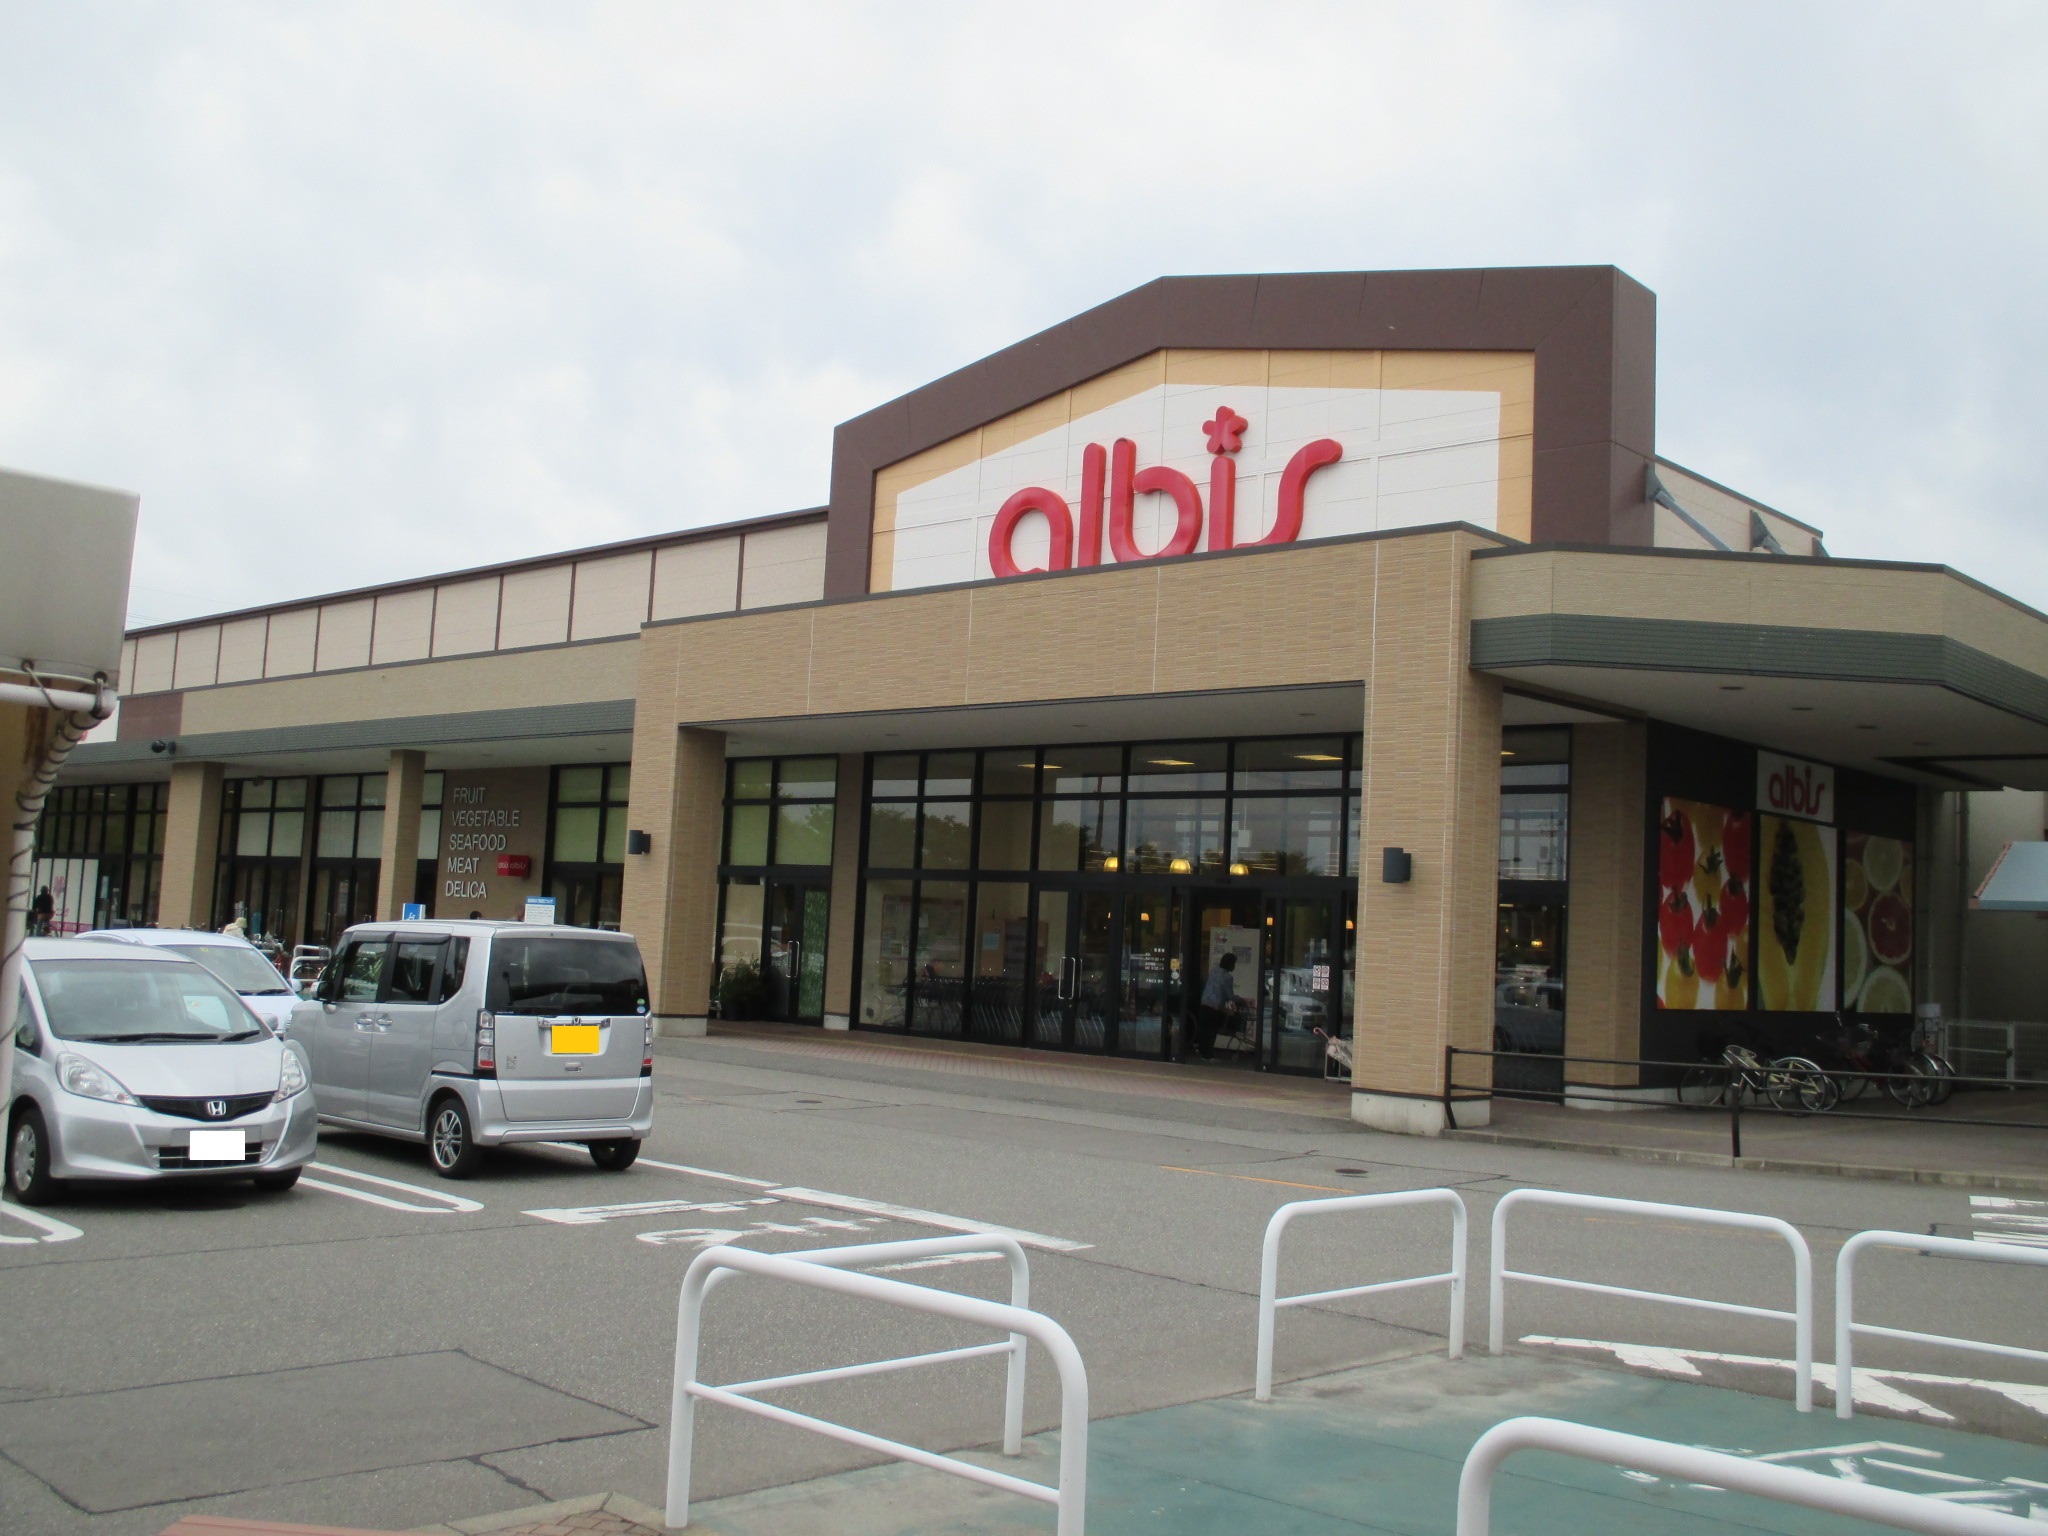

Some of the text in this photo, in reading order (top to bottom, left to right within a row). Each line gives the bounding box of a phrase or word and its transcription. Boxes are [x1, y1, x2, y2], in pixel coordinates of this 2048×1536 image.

[989, 405, 1343, 578] albis
[453, 787, 486, 804] FRUIT
[1768, 764, 1825, 816] albis
[452, 810, 520, 827] VEGETABLE
[449, 834, 506, 851] SEAFOOD
[447, 857, 479, 874] MEAT
[445, 880, 487, 899] DELICA
